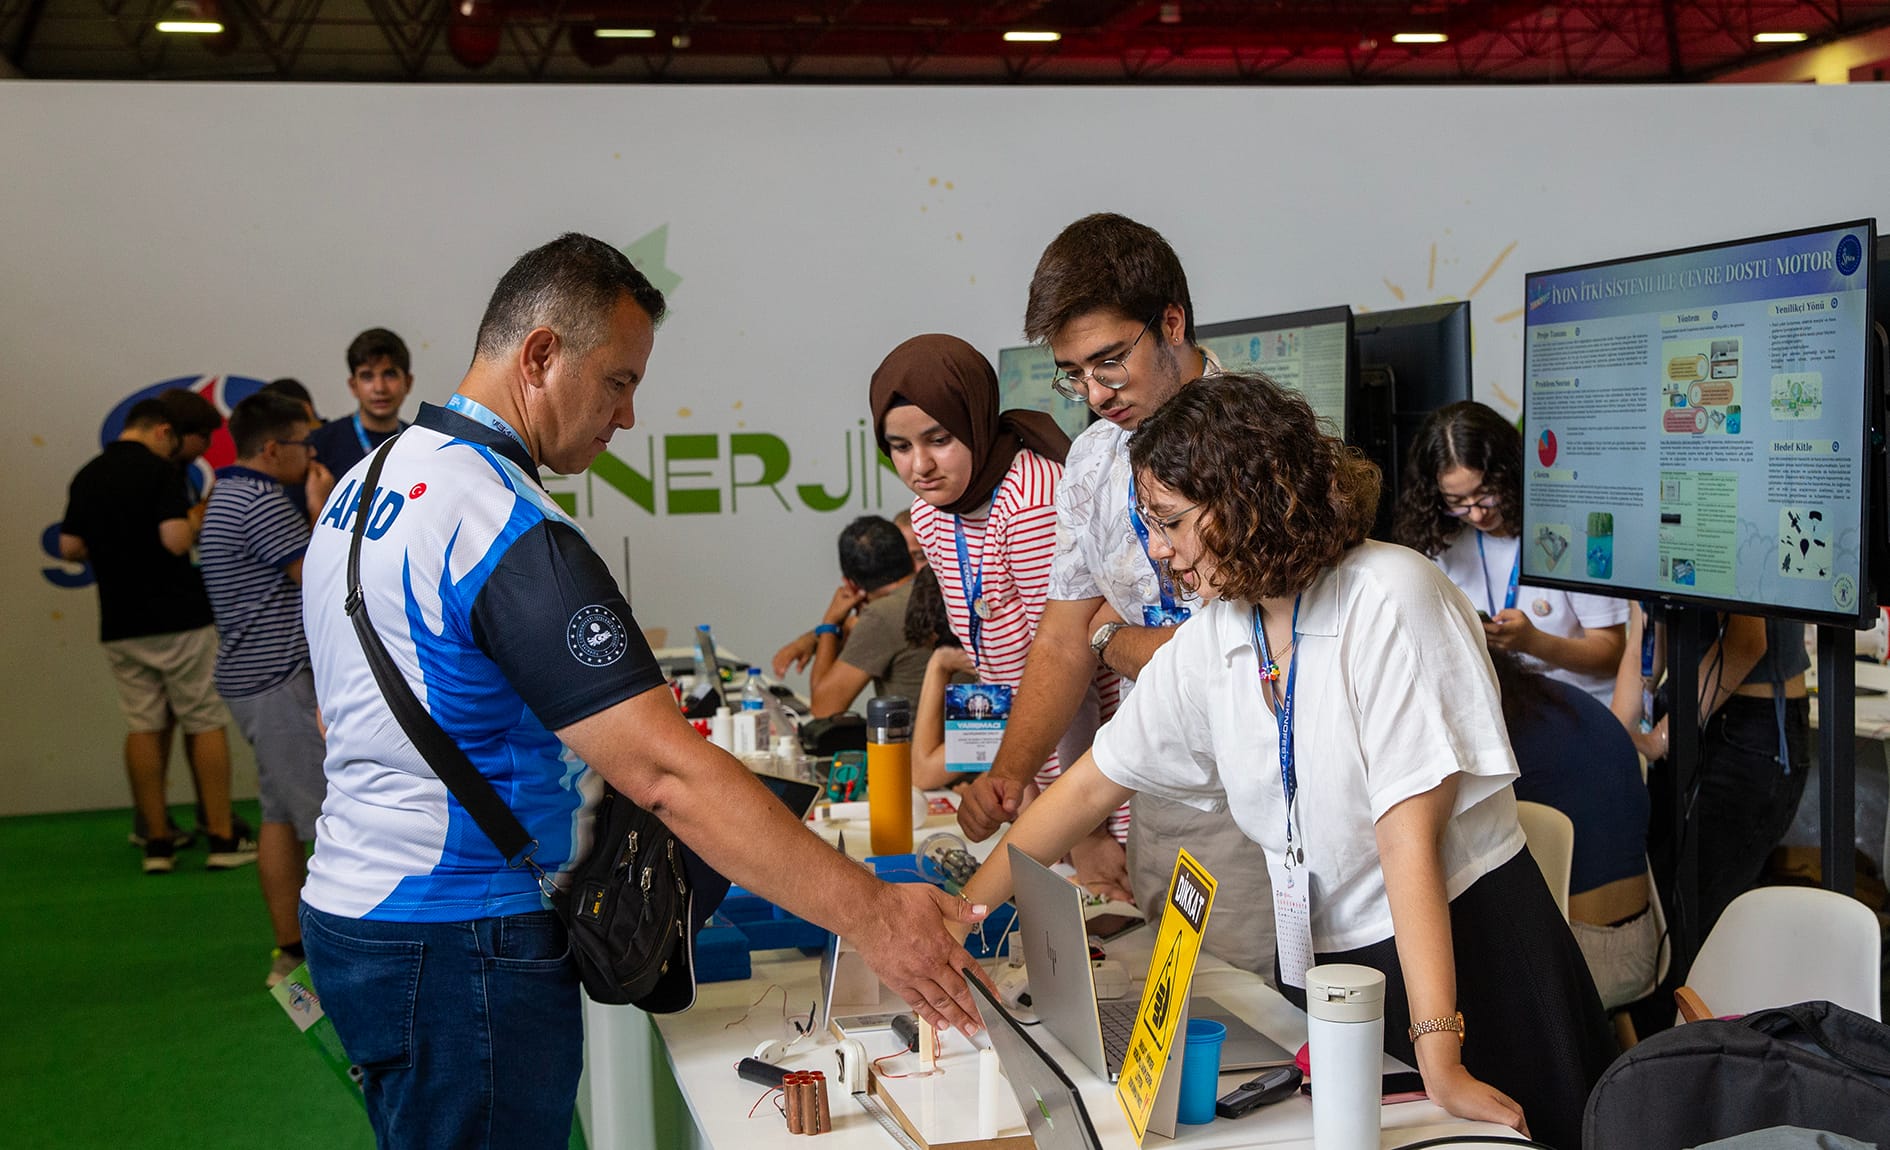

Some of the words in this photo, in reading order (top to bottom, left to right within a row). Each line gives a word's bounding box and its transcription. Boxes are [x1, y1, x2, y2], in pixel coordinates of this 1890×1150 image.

[1679, 265, 1722, 291] ÇEVRE
[1726, 258, 1773, 282] DOSTU
[1776, 250, 1833, 276] MOTOR
[1774, 302, 1805, 315] Yenilikçi
[1807, 299, 1826, 312] Yönü
[1773, 441, 1795, 453] Hedef
[1795, 441, 1813, 453] Kitle
[1174, 872, 1205, 924] DİKKAT
